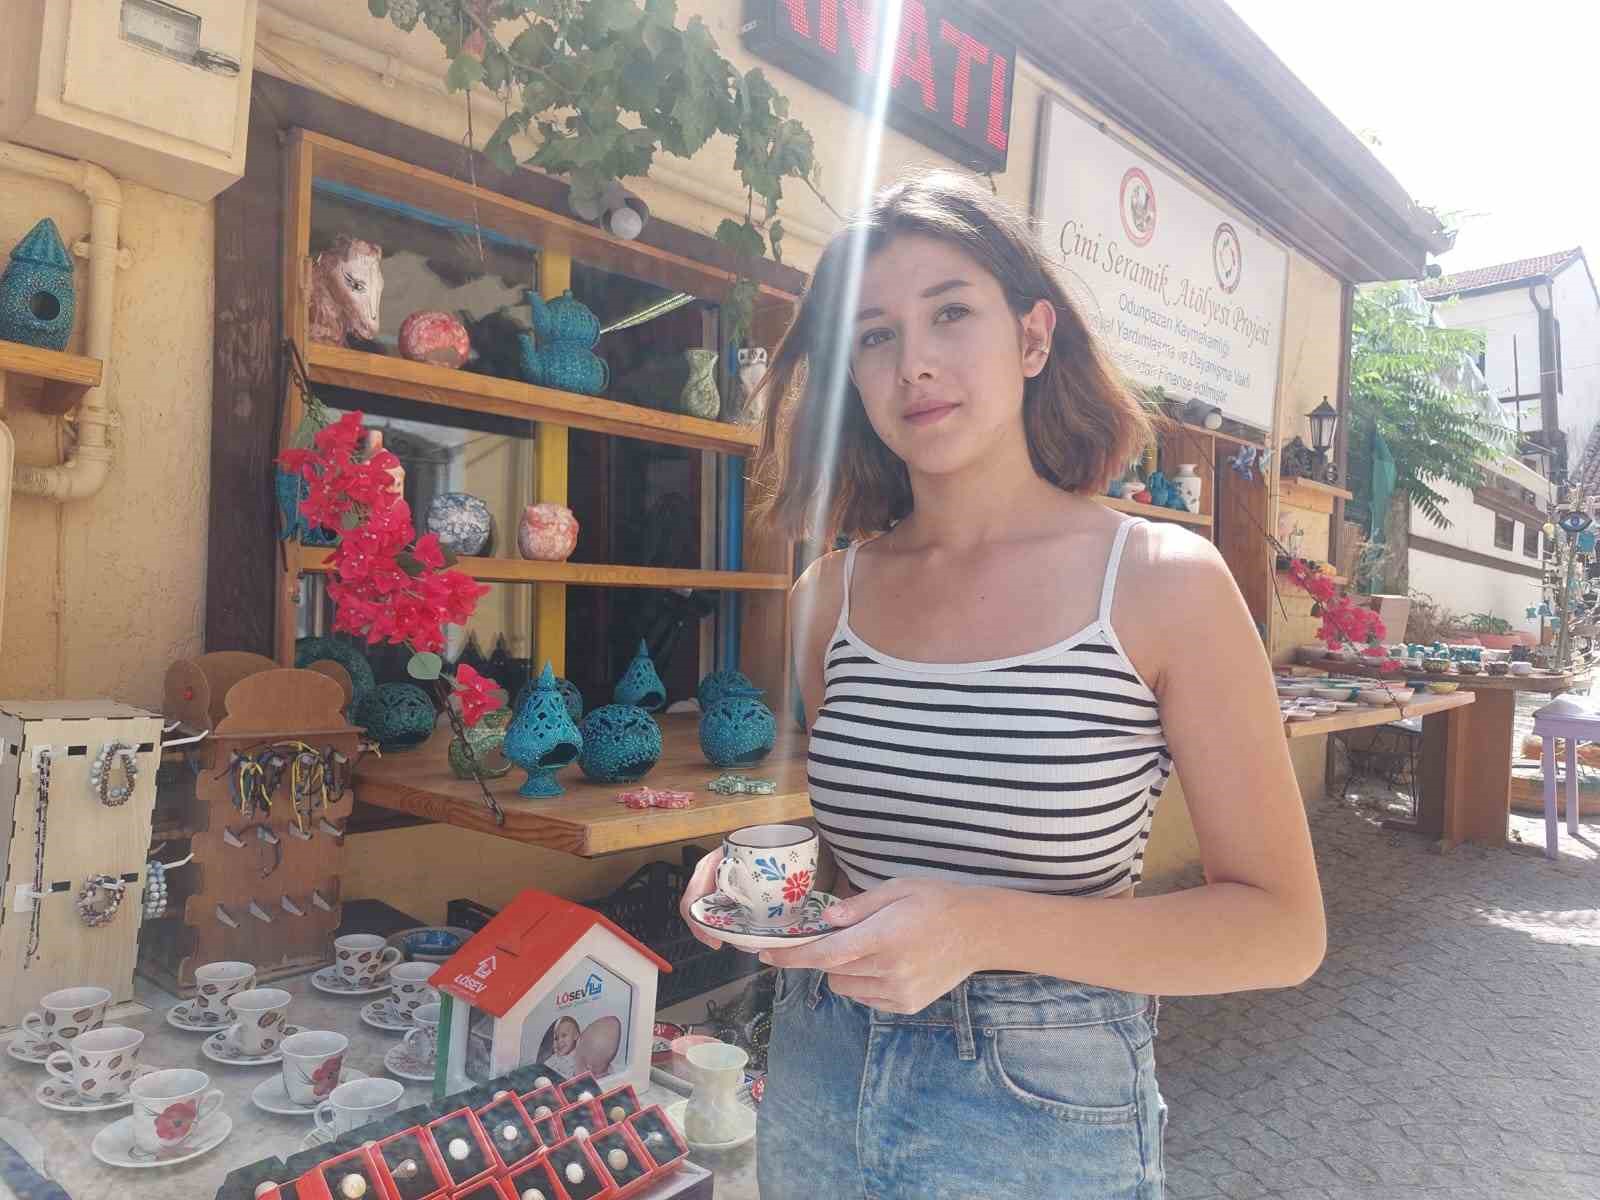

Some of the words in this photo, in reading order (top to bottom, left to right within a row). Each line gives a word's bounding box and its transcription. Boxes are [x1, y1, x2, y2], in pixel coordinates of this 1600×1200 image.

[1060, 220, 1101, 266] Çini
[1101, 240, 1171, 306] Seramik
[1232, 303, 1272, 348] Projesi
